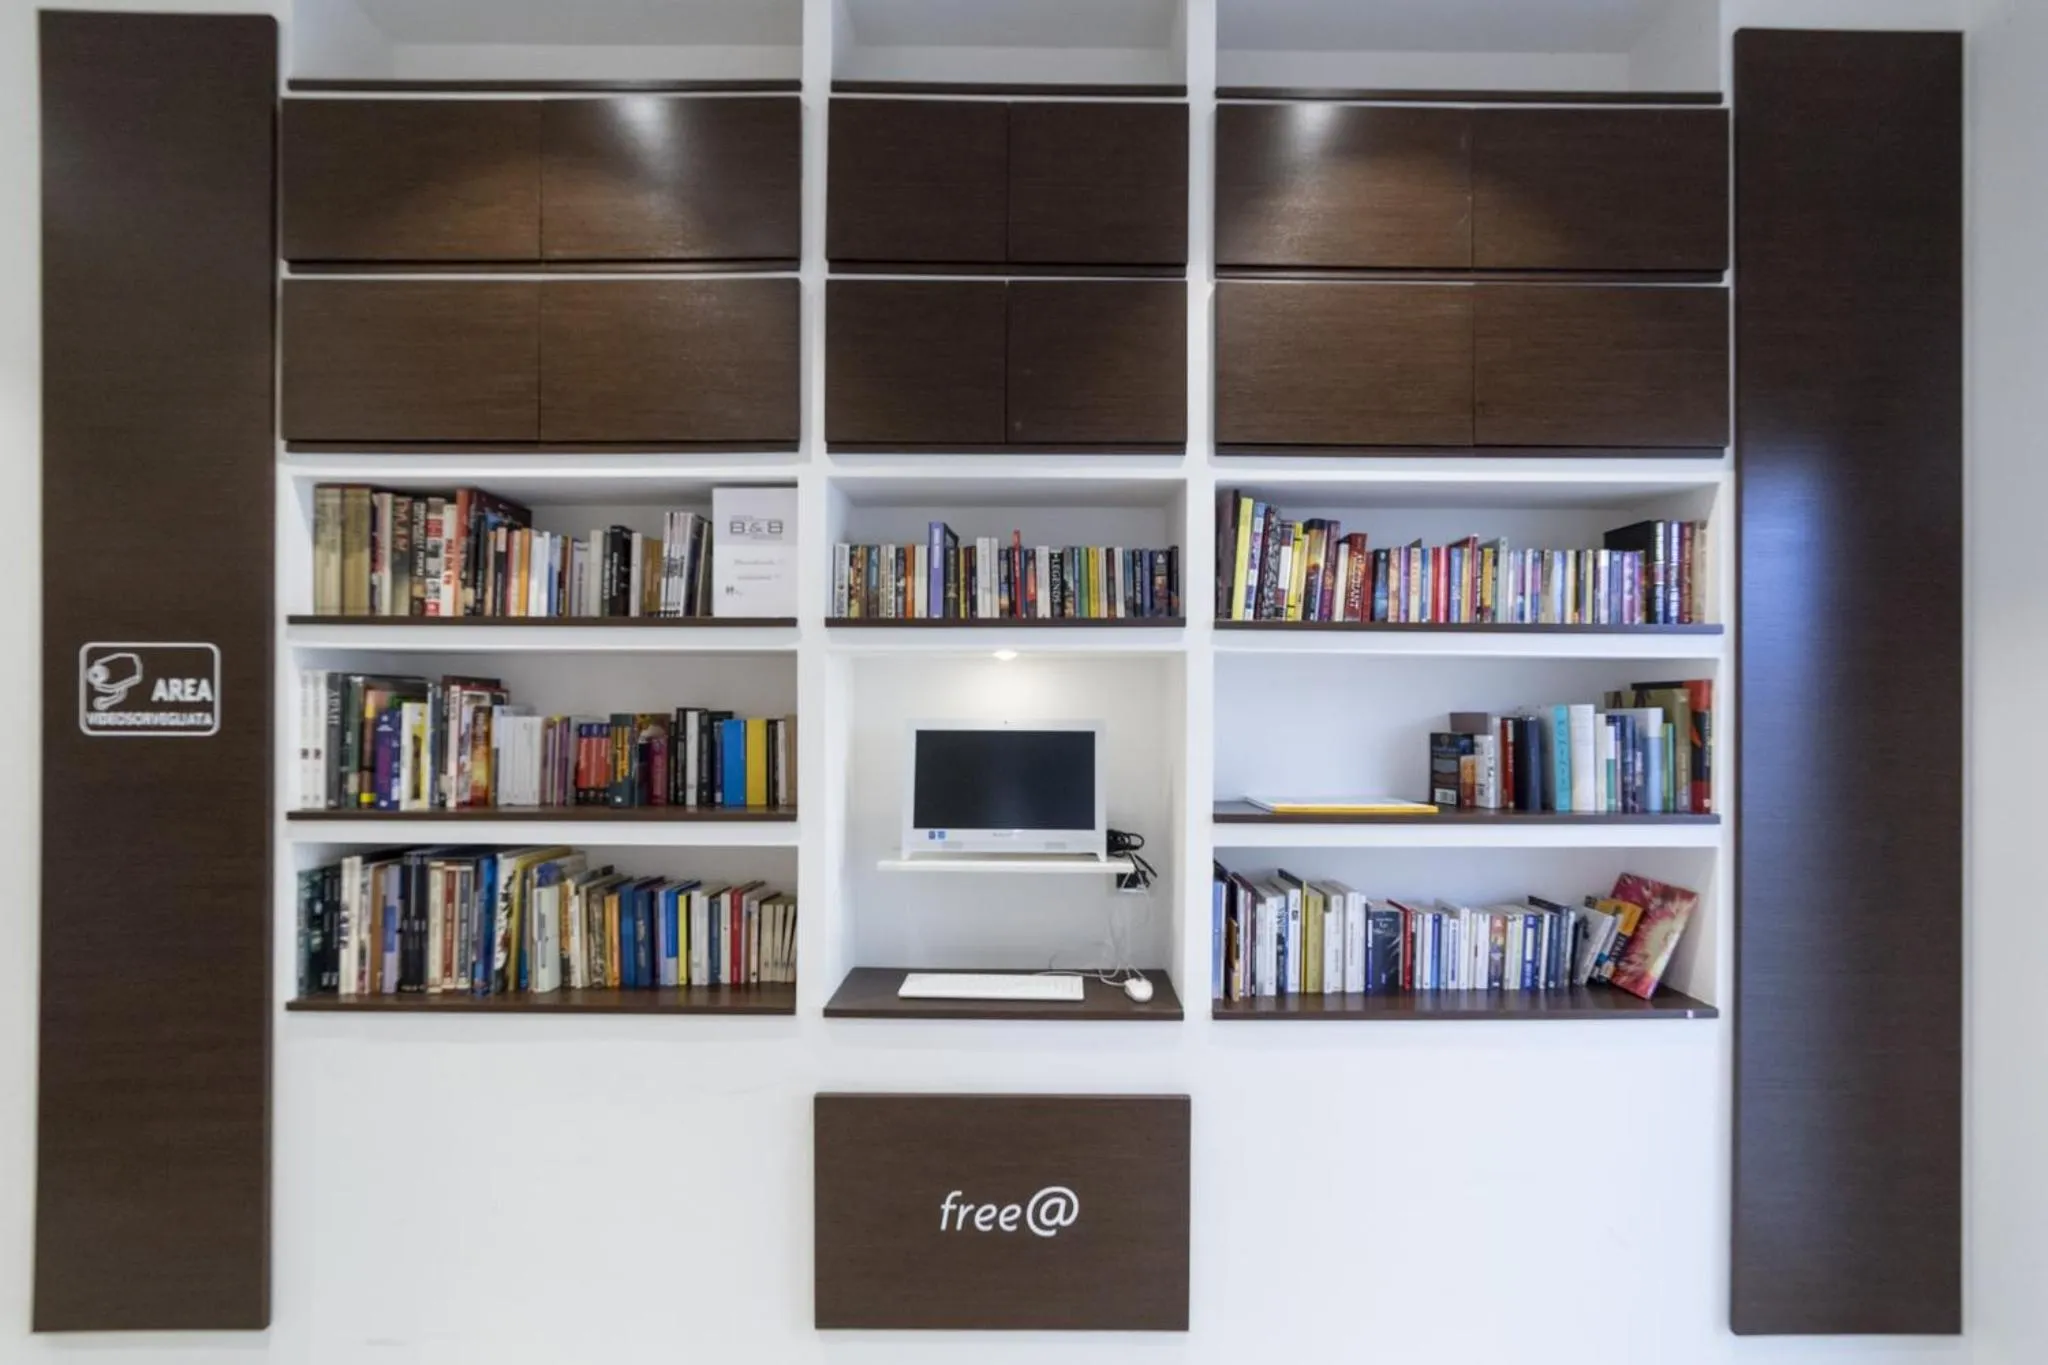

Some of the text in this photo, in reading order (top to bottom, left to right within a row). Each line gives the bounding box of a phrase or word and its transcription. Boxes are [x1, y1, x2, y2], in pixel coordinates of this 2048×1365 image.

[1051, 559, 1061, 603] LEGENDS
[150, 677, 214, 702] AREA
[940, 1186, 1080, 1237] free@
